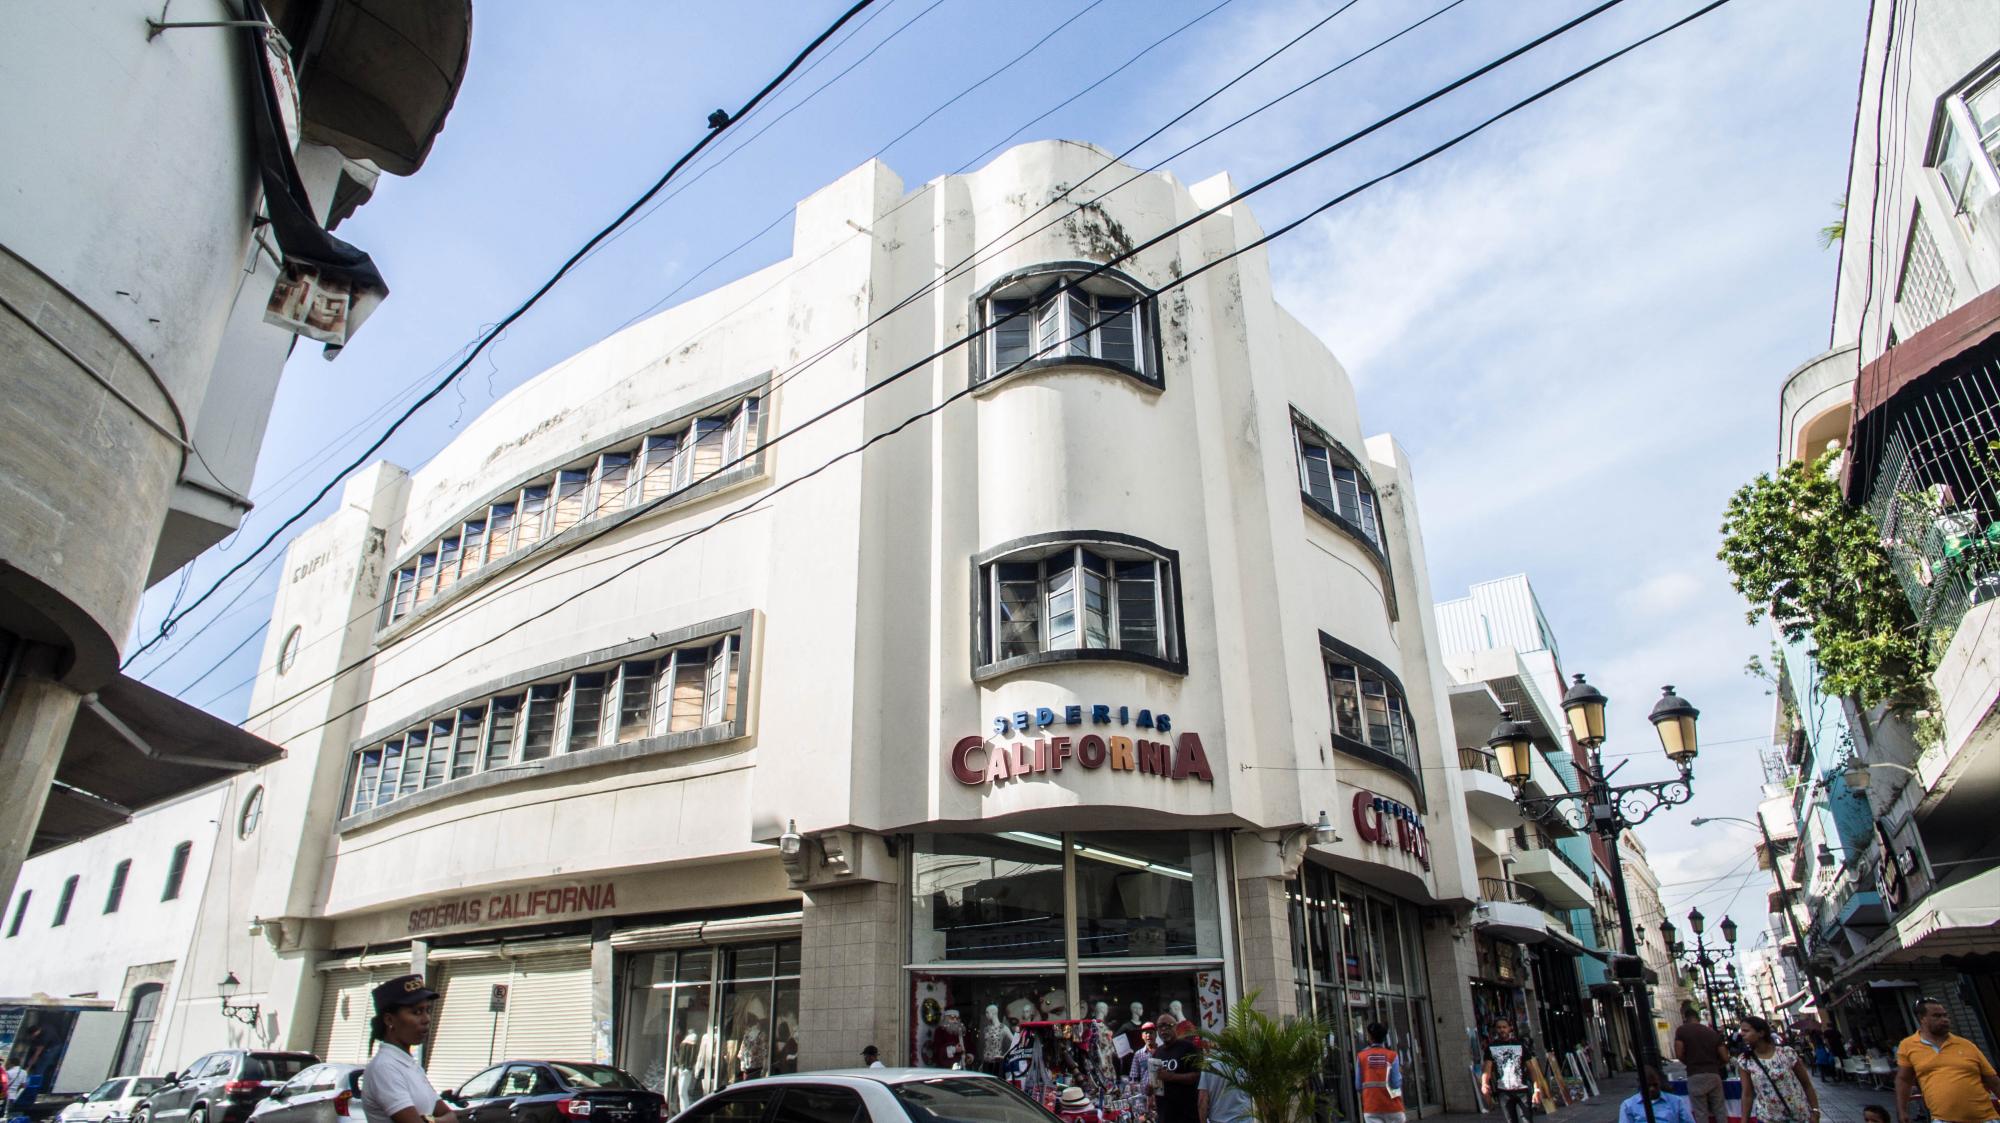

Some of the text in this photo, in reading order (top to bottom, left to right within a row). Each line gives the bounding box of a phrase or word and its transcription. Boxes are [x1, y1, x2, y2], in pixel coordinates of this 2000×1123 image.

[993, 704, 1172, 735] SEDERIAS
[951, 732, 1214, 785] CALIFORNIA
[408, 883, 615, 931] SEDERIAS CALIFORNIA
